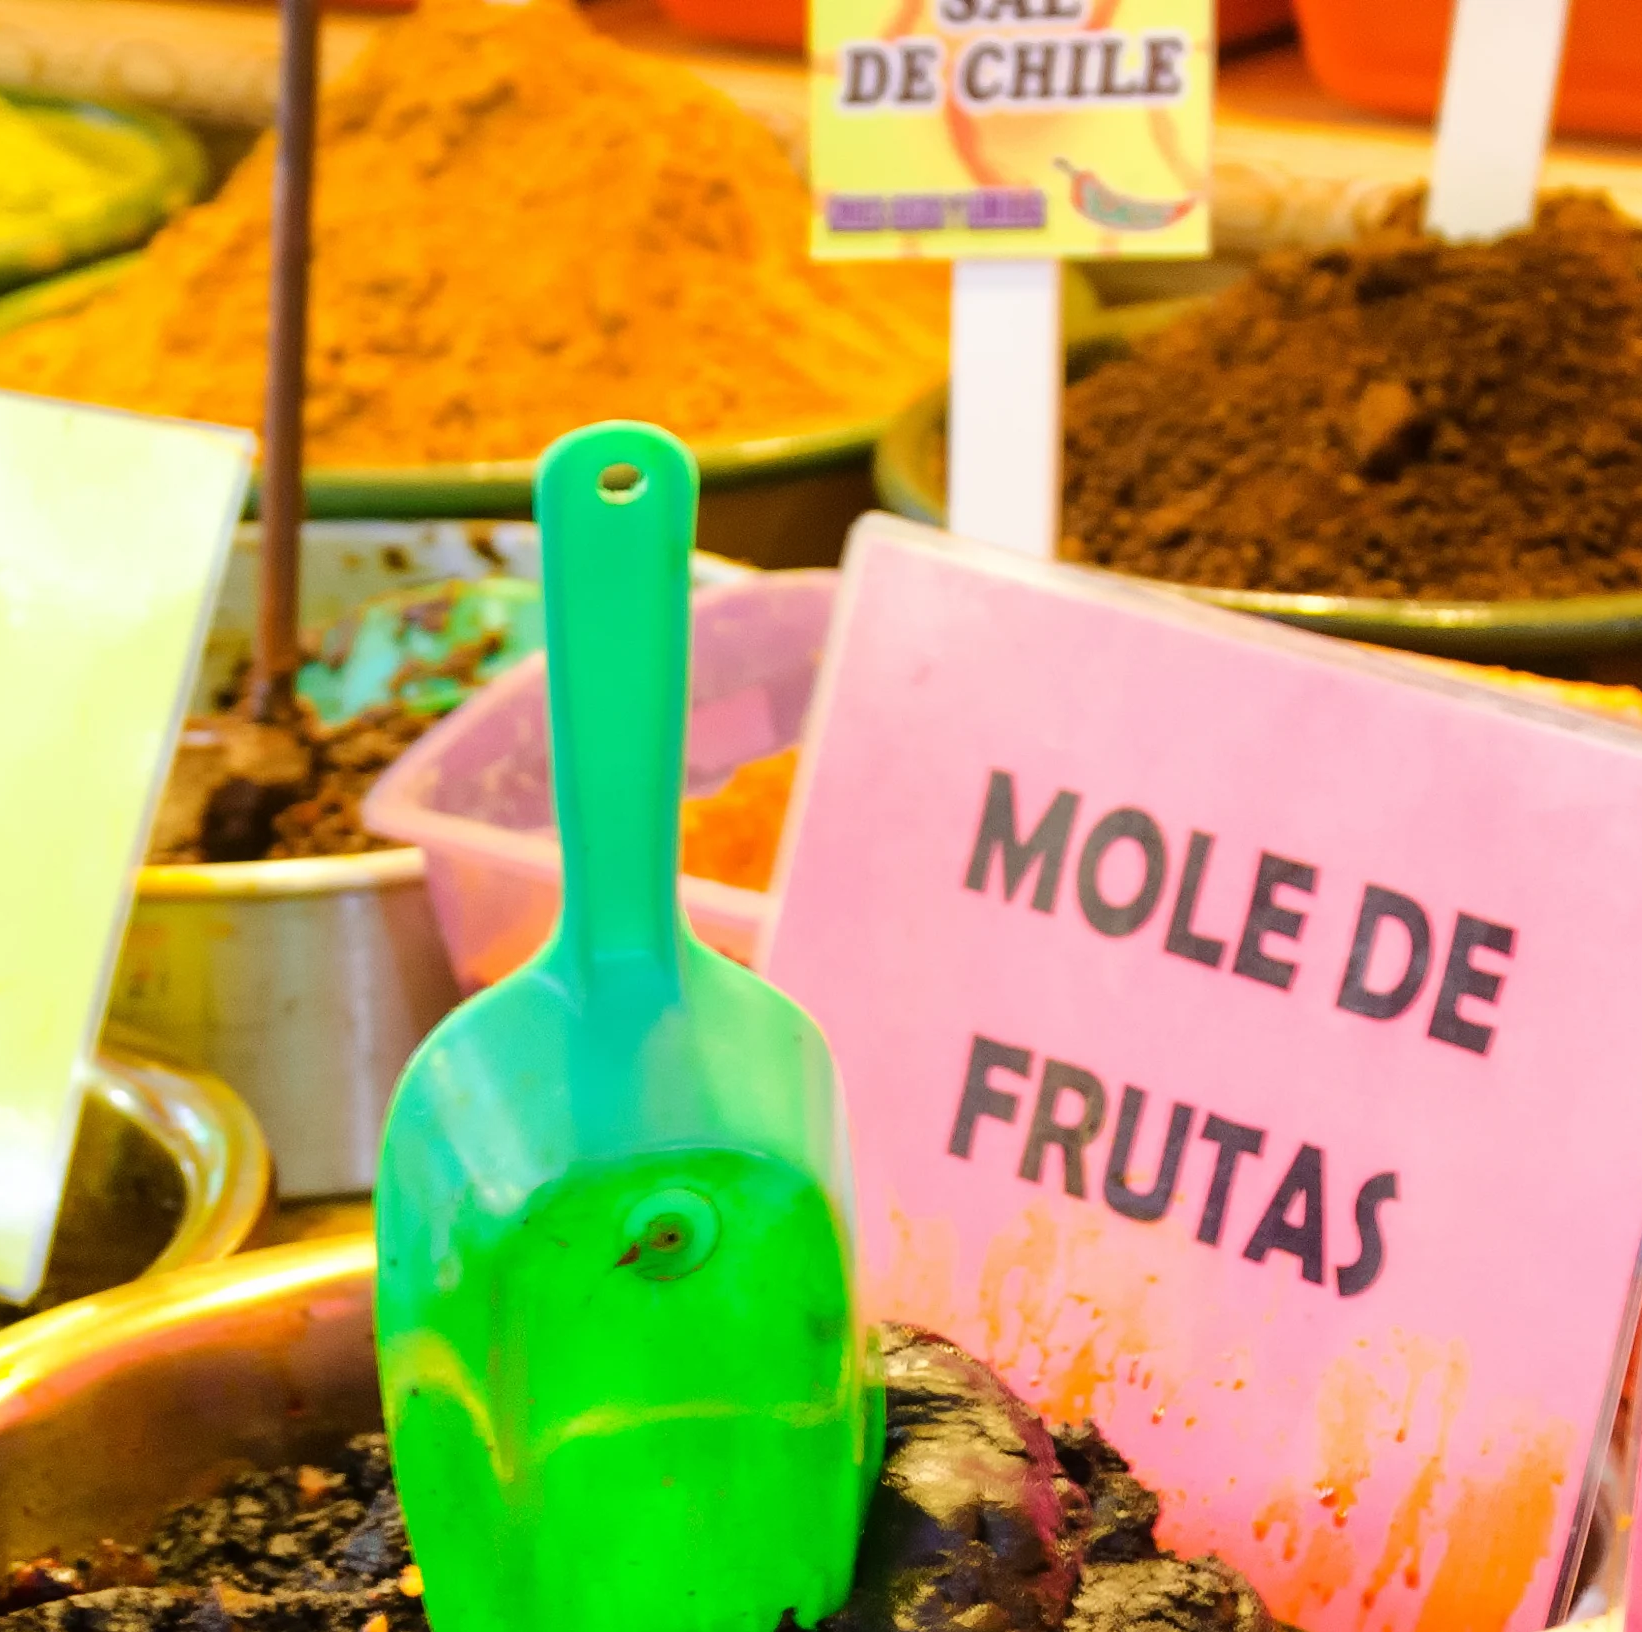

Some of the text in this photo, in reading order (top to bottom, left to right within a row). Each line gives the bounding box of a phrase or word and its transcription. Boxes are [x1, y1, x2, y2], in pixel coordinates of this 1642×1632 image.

[843, 37, 1184, 105] DE CHILE
[964, 768, 1516, 1056] MOLE DE
[947, 1034, 1399, 1298] FRUTAS
